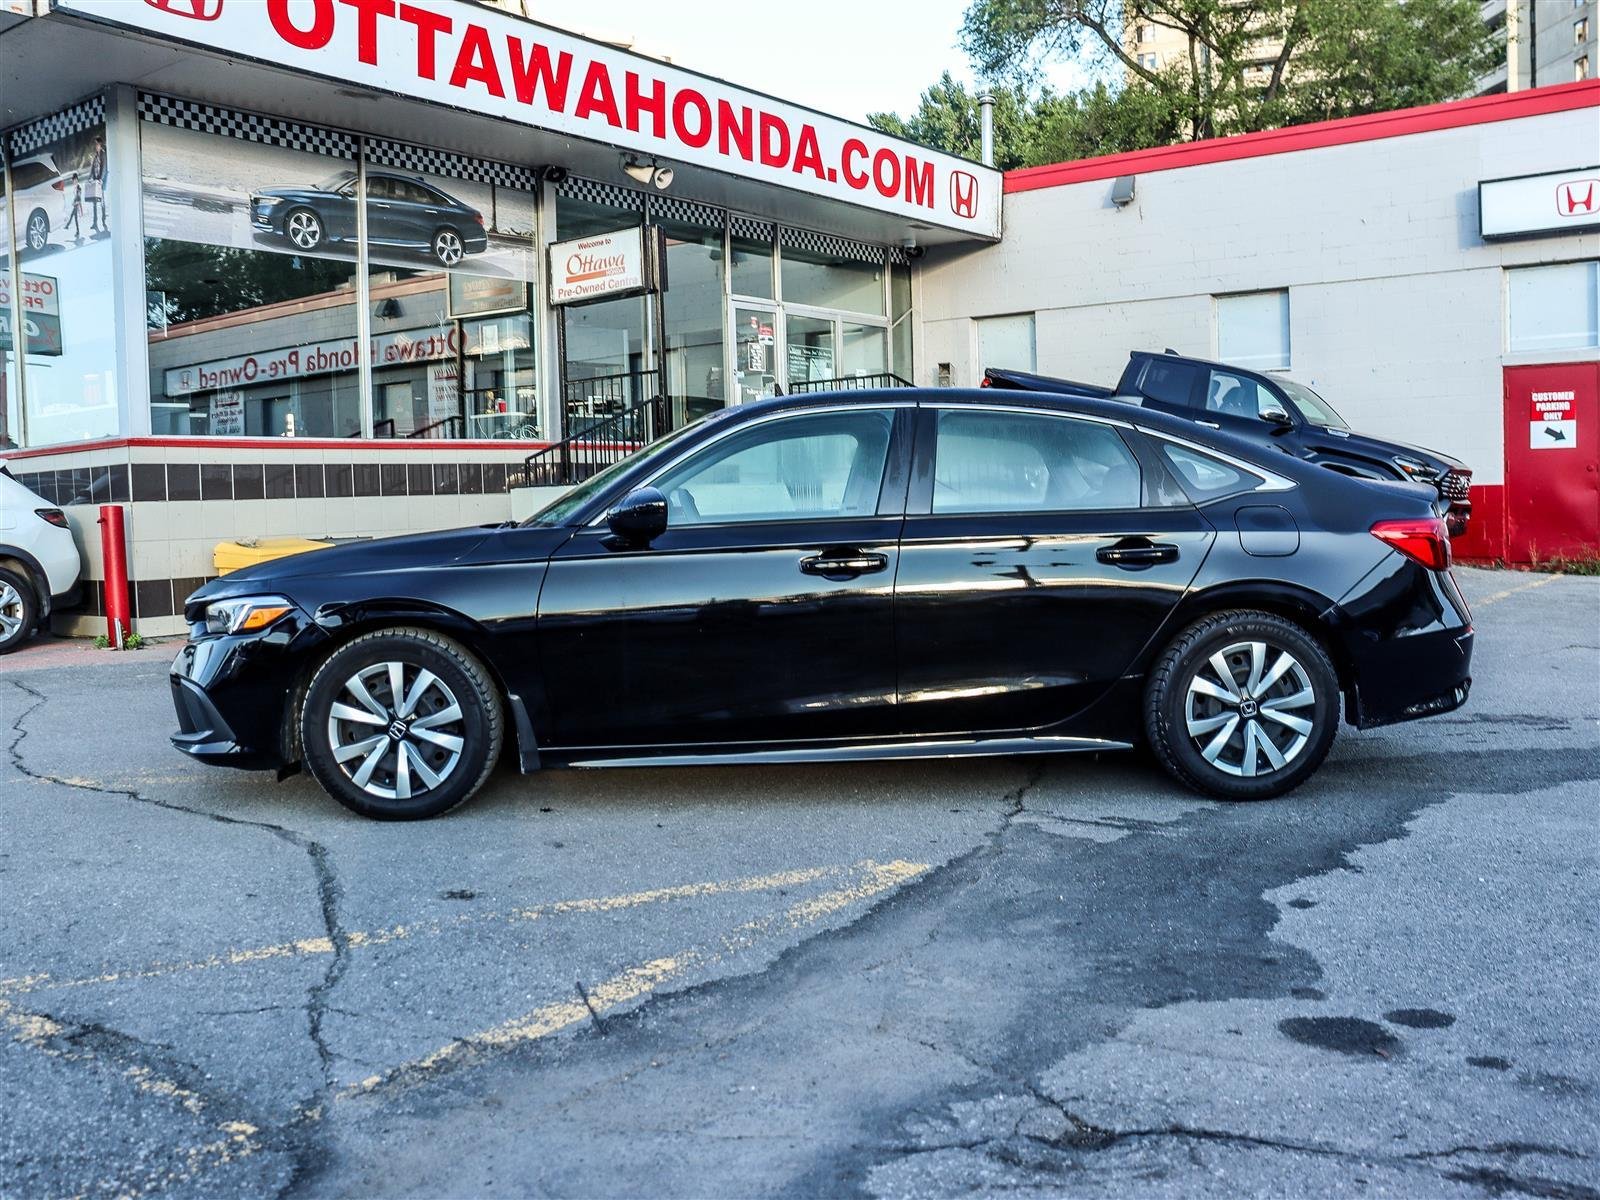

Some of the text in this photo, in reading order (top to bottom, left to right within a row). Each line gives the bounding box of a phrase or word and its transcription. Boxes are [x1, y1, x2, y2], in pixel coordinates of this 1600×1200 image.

[267, 0, 934, 209] OTTAWAHONDA.COM
[577, 237, 613, 251] Welcome to
[566, 253, 625, 275] Ottawa
[558, 277, 640, 298] Pre-Owned Centre
[1531, 391, 1575, 402] CUSTOMER
[1535, 401, 1571, 412] PARKING
[1543, 411, 1563, 421] ONLY
